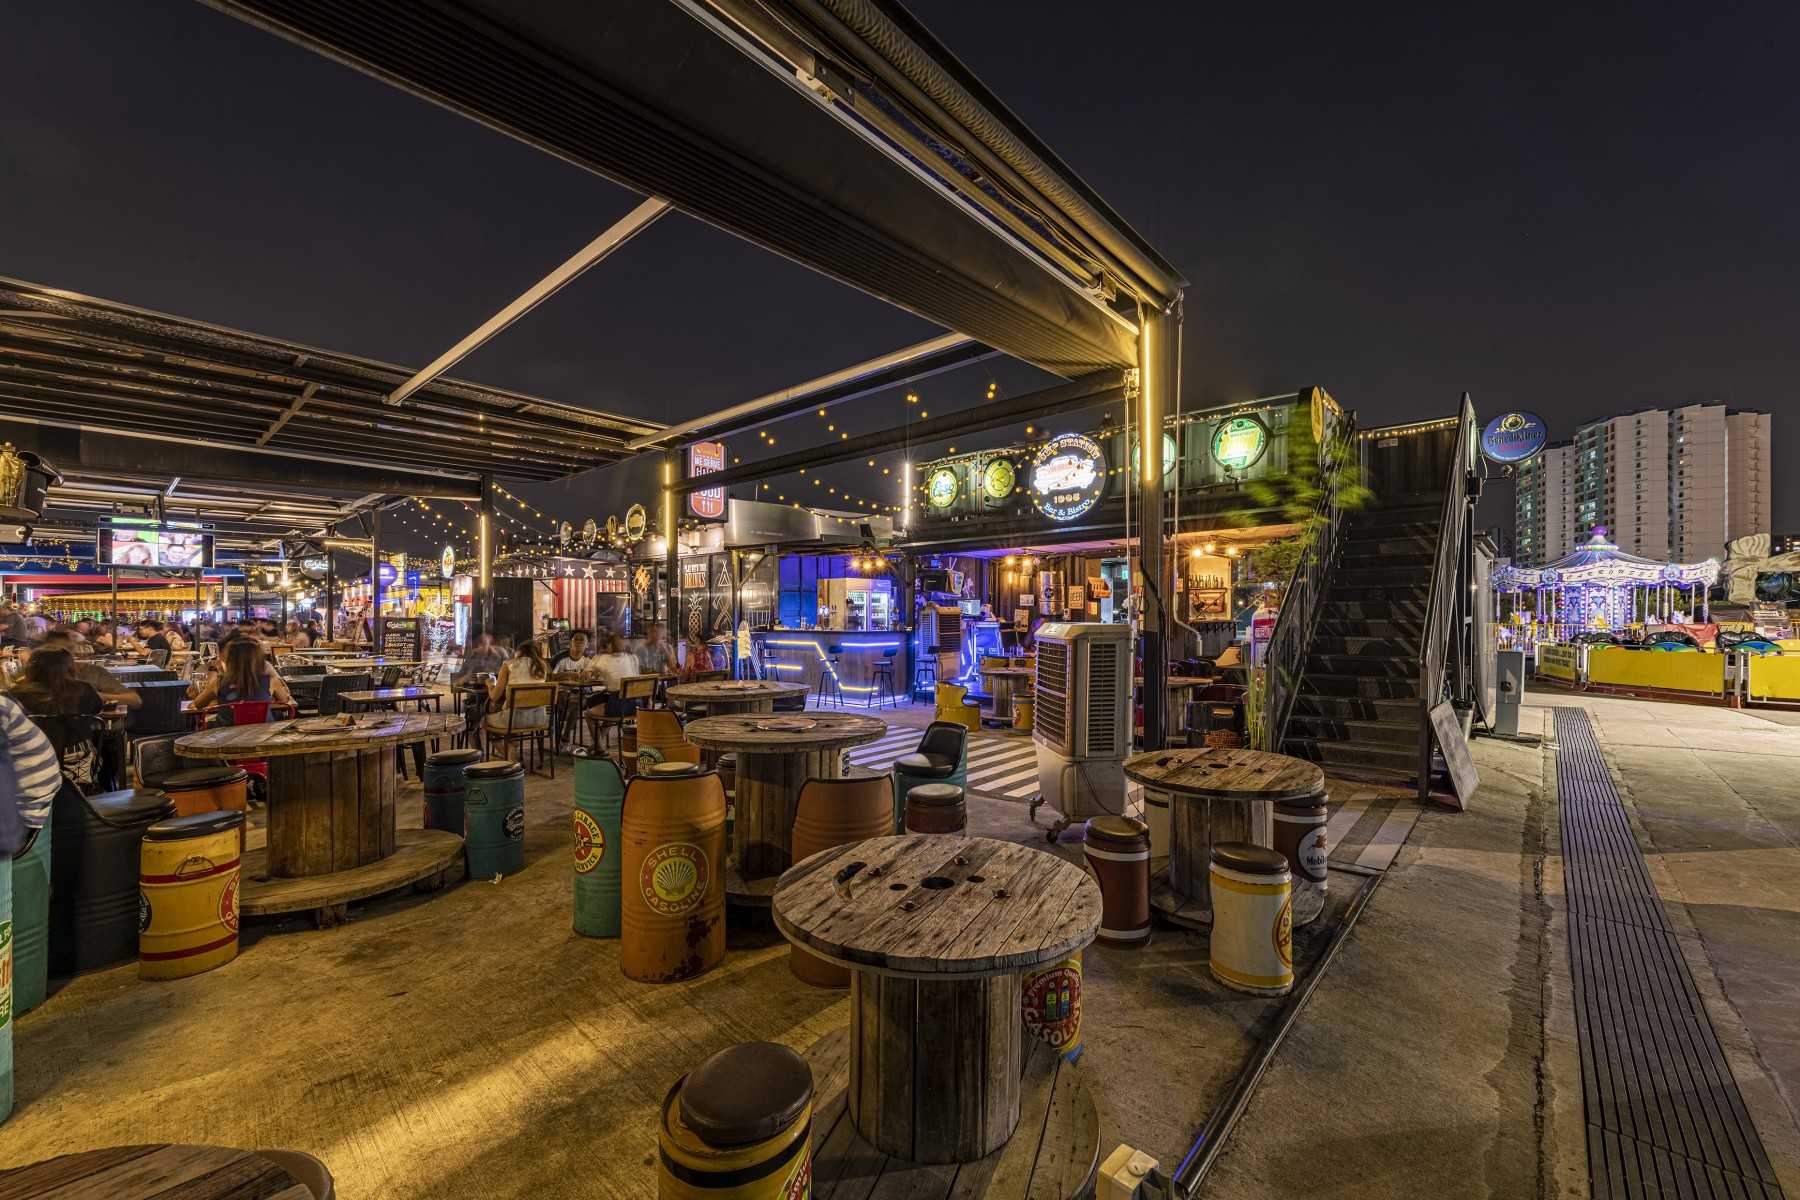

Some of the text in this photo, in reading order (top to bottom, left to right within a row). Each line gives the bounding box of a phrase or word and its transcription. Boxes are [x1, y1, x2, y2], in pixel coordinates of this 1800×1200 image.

[1044, 502, 1057, 514] Bar
[1067, 499, 1090, 516] Bistro
[648, 847, 697, 868] SHELL
[645, 881, 705, 912] GASOLINE
[1027, 970, 1063, 997] Premium
